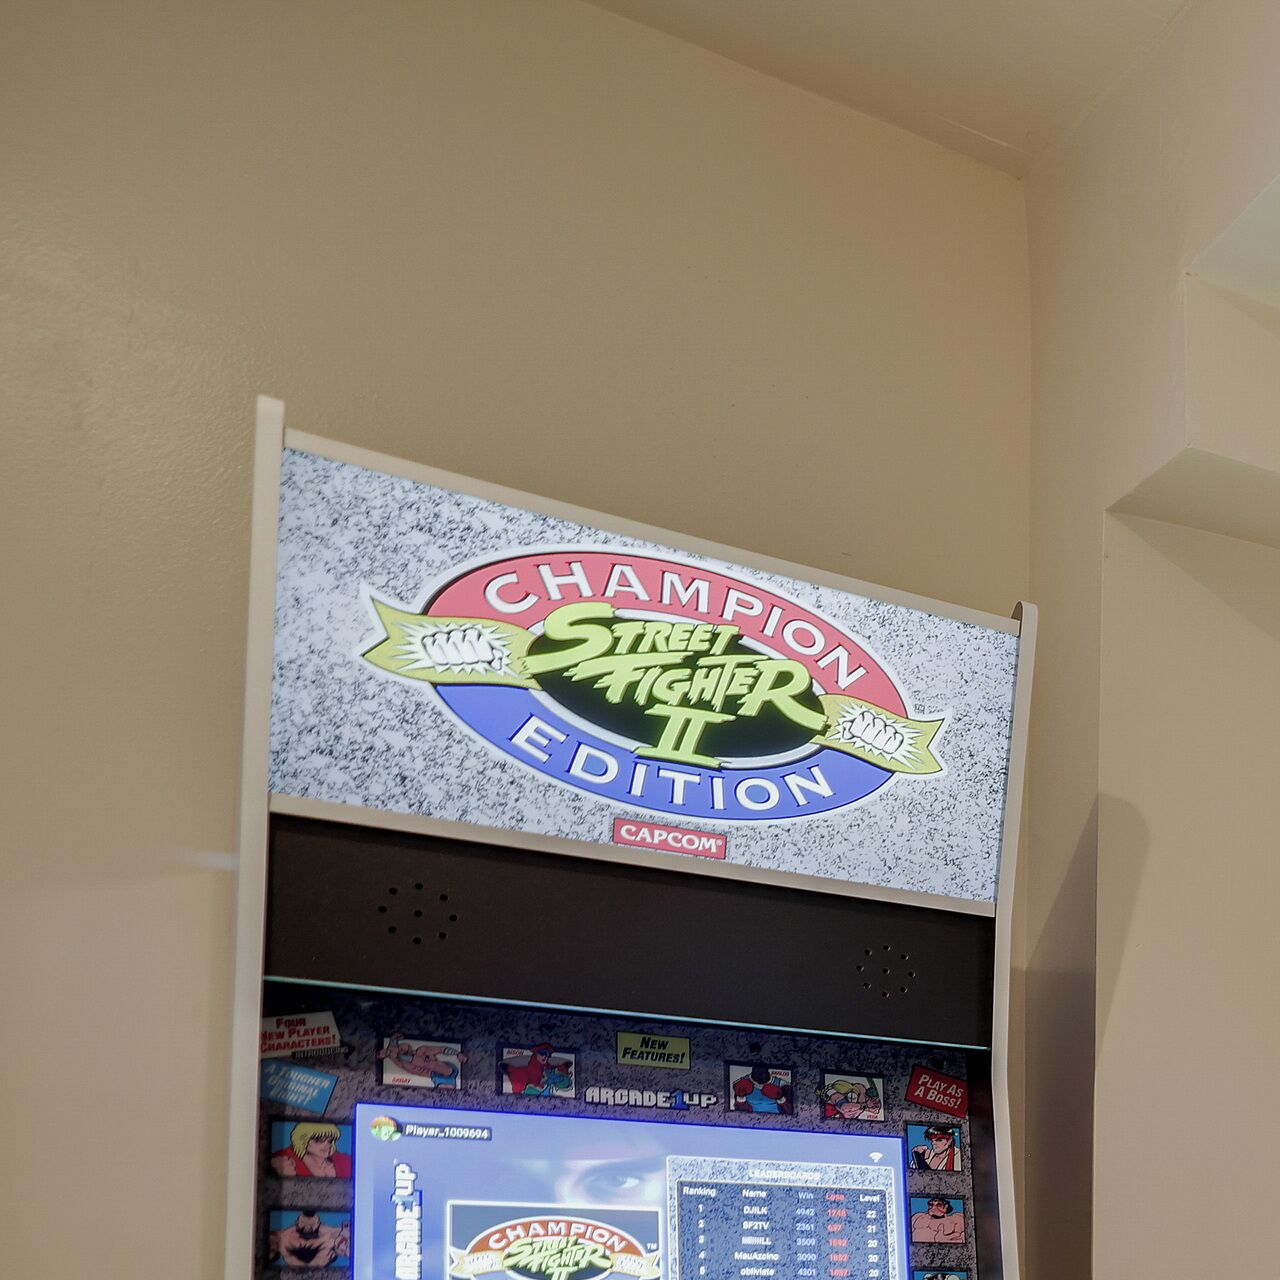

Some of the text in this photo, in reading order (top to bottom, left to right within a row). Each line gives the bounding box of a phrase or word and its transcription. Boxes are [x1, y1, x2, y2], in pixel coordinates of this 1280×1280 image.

[483, 562, 867, 692] CHAMPION
[524, 602, 740, 673] STREET
[570, 650, 828, 732] FIGHTER
[509, 711, 837, 811] EDITION
[619, 822, 719, 854] CAPCOM
[288, 1026, 330, 1038] PLAYER
[640, 1036, 669, 1049] NEW
[622, 1047, 685, 1064] FEATURES!
[914, 1086, 962, 1109] A BOSS!
[918, 1074, 964, 1097] PLAY AS
[683, 1187, 716, 1198] Ranking
[742, 1190, 767, 1198] Name
[798, 1191, 813, 1199] Win
[860, 1194, 880, 1202] Level
[488, 1222, 628, 1252] CHAMPION
